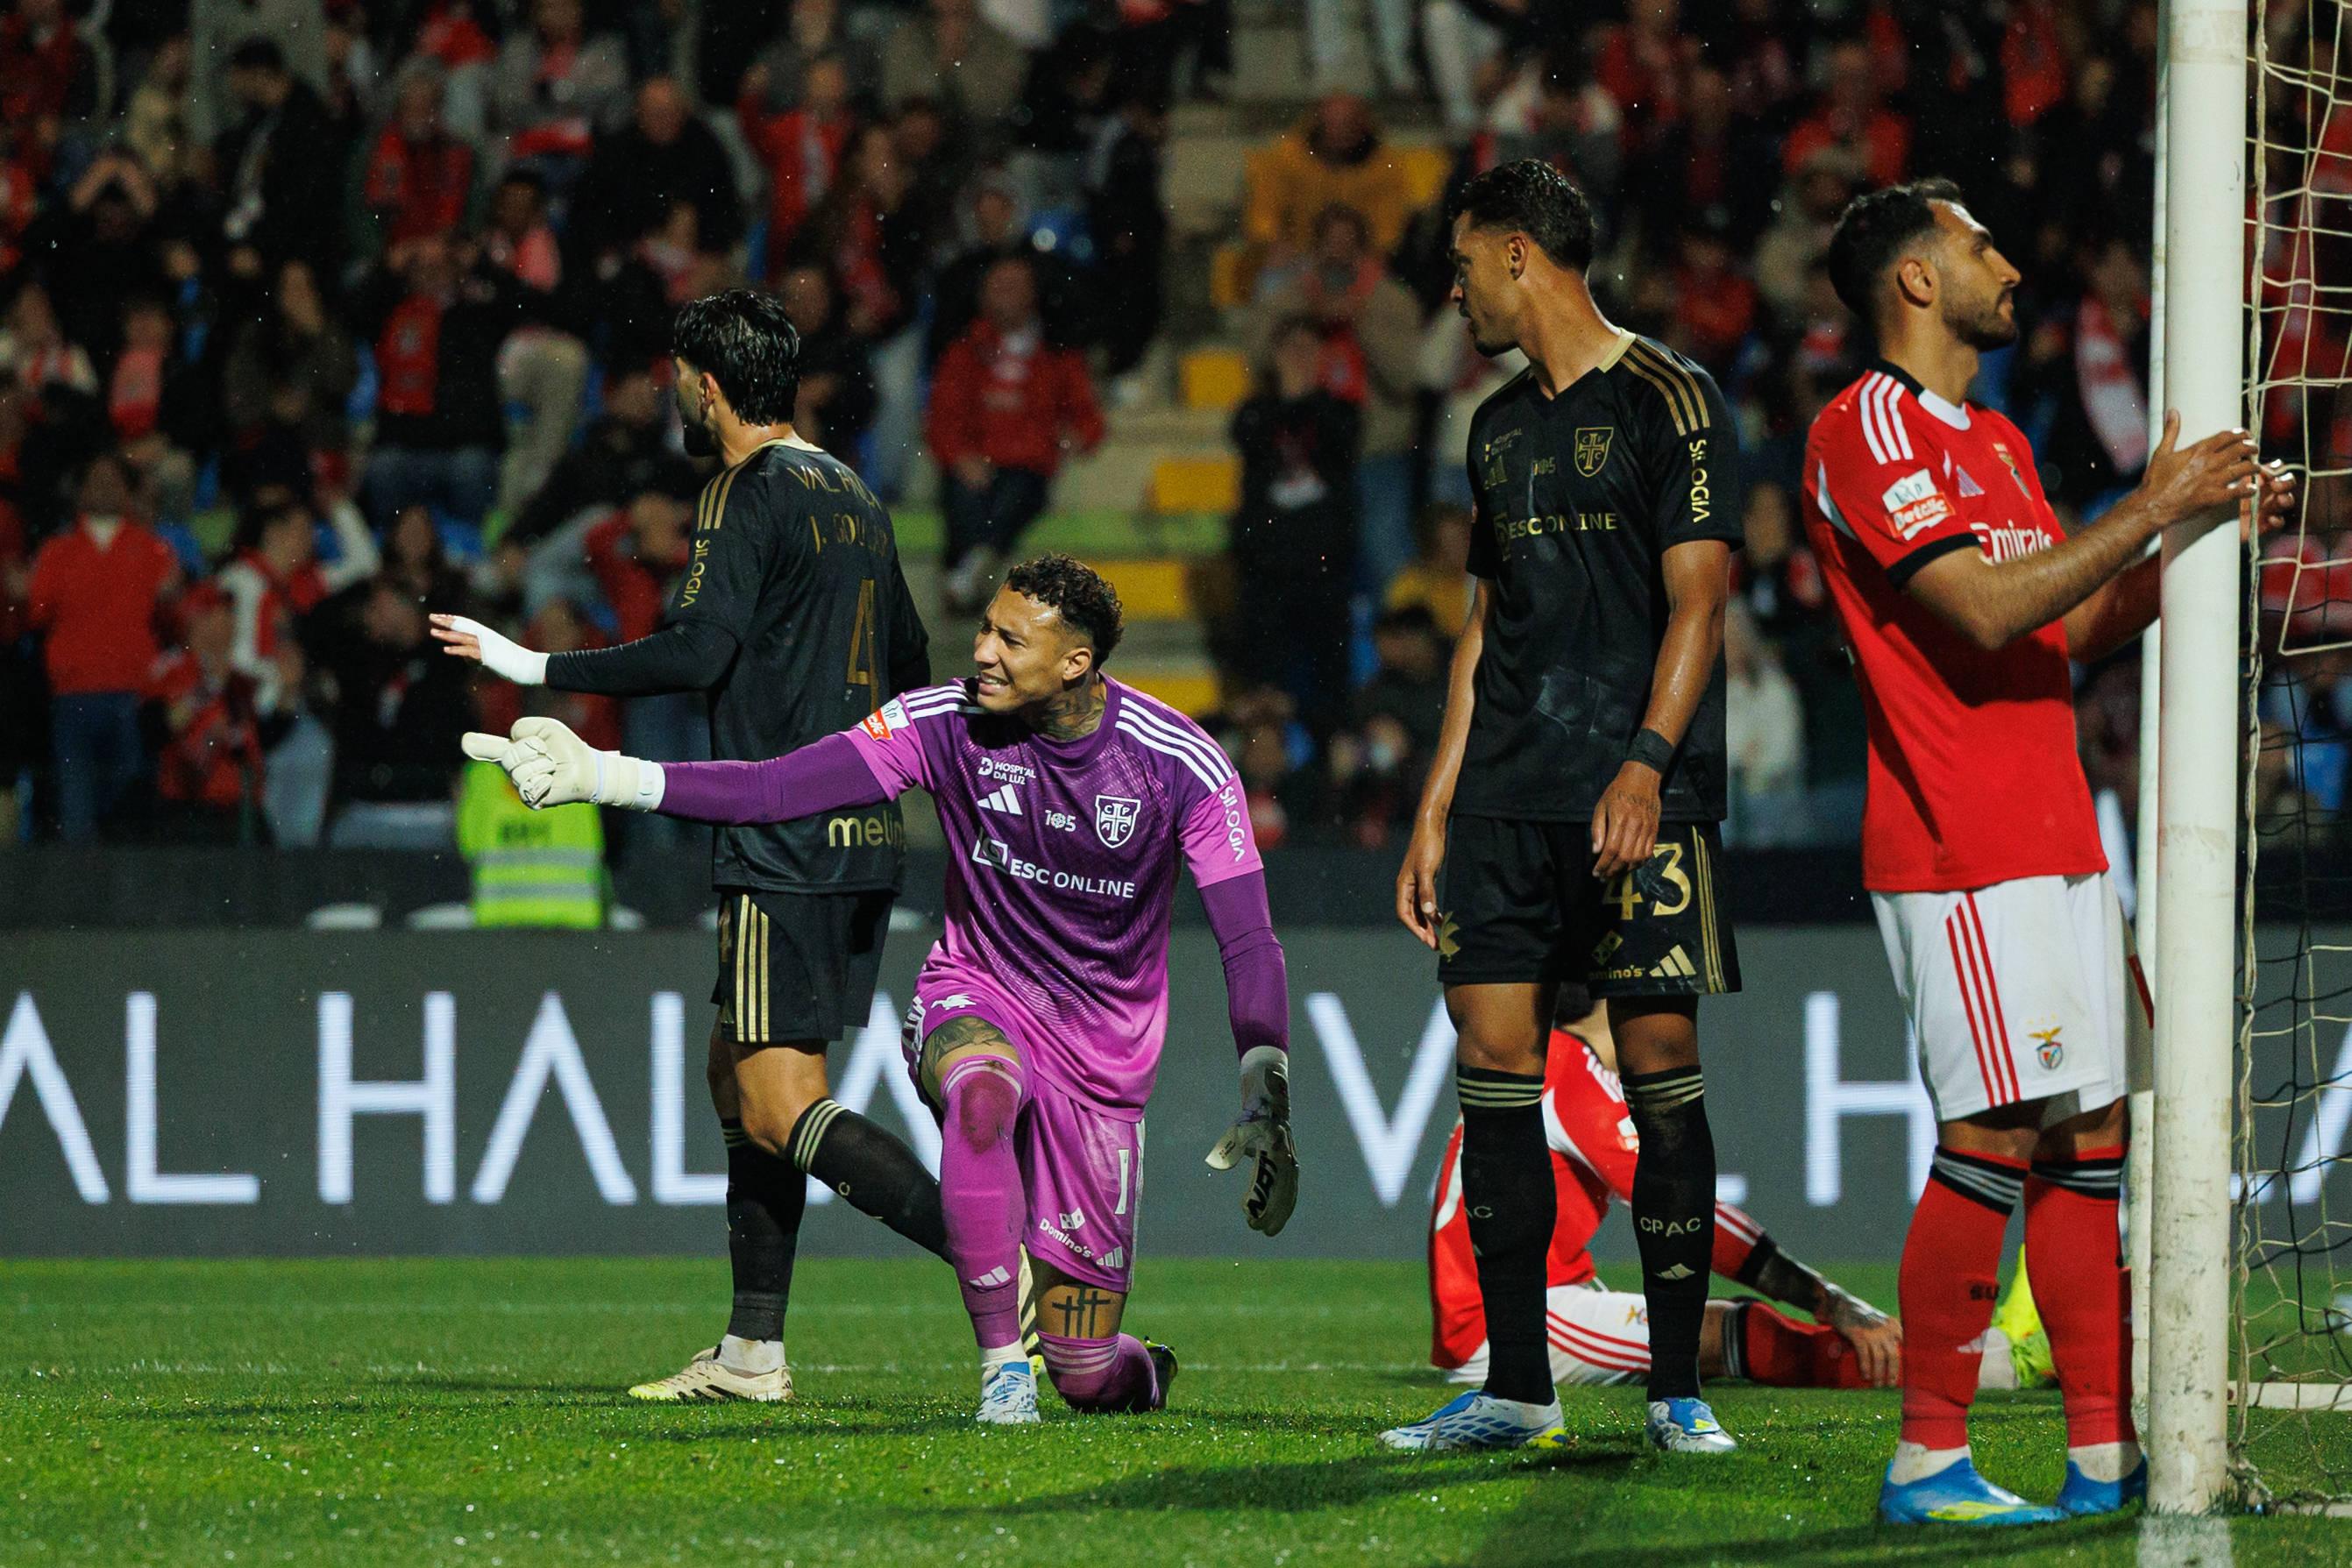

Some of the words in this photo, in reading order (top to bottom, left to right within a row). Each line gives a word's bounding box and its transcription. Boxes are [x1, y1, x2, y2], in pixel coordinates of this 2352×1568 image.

[680, 539, 710, 608] SILOGIA
[847, 578, 878, 713] 4
[993, 771, 1007, 782] DA
[1009, 859, 1051, 884] ESC
[1054, 872, 1135, 898] ONLINE
[1602, 842, 1692, 920] 43
[1114, 1149, 1129, 1215] 1
[1039, 1217, 1093, 1259] Domino's
[1639, 1216, 1702, 1238] CPAC
